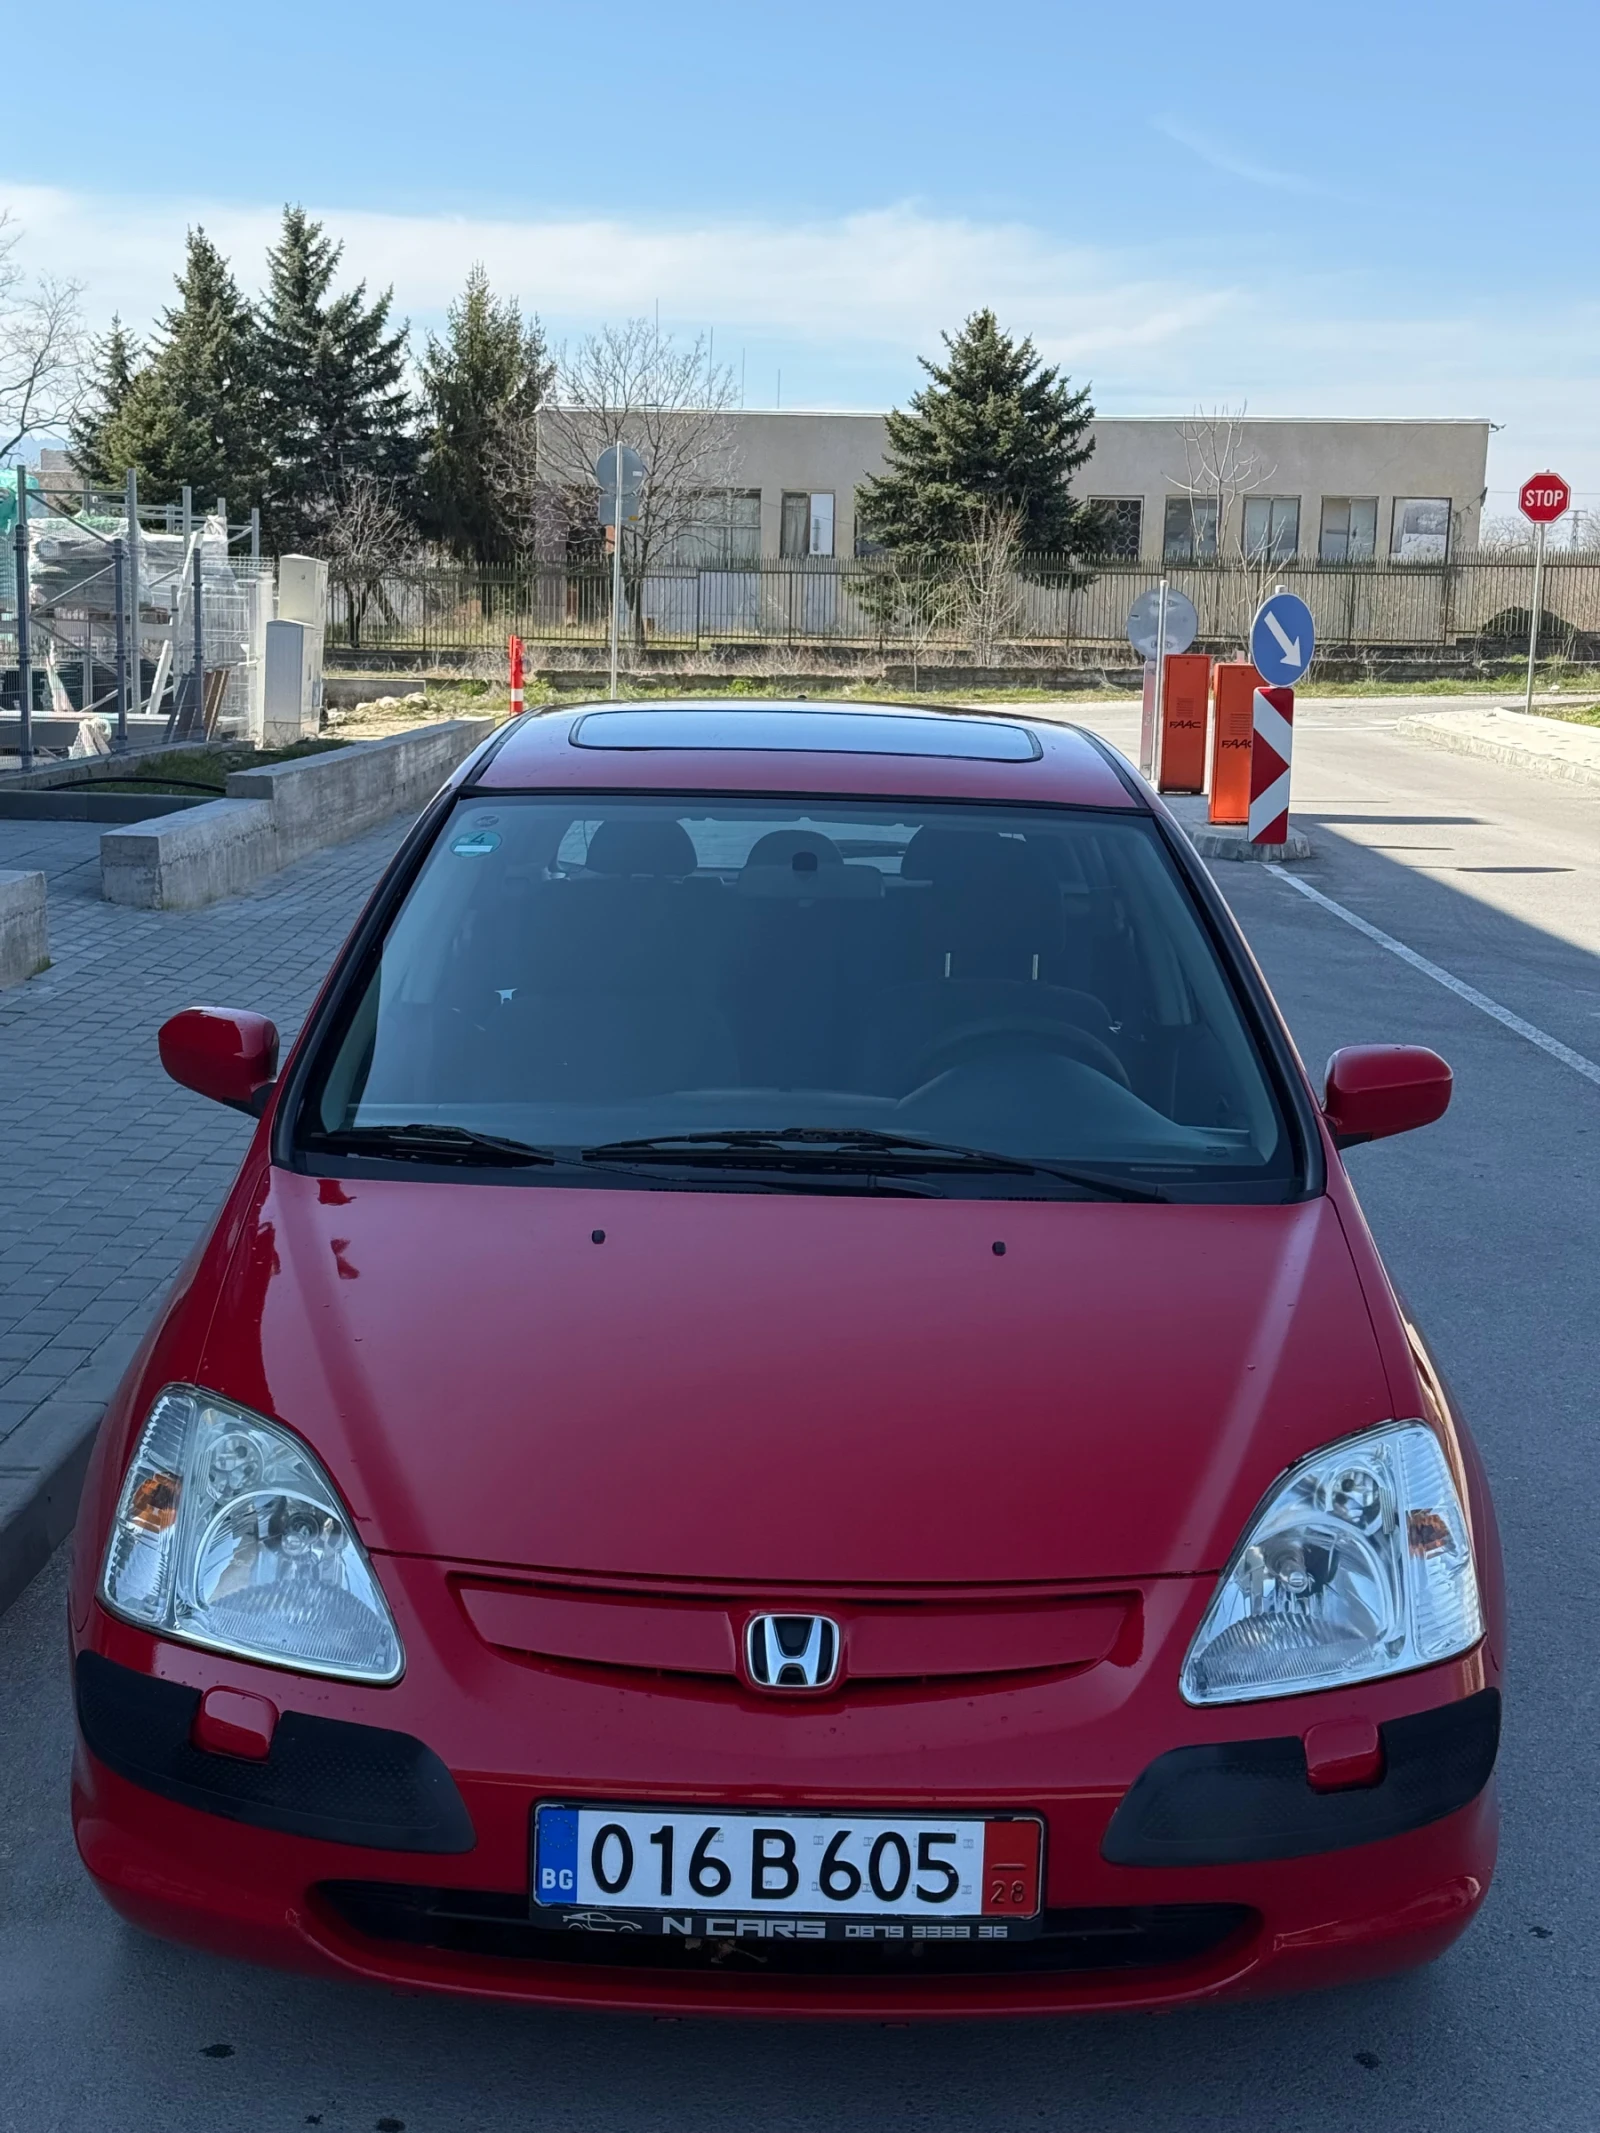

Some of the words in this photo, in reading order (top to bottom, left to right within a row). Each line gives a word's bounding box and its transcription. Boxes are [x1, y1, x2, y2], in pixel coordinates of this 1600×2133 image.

[1525, 489, 1564, 507] STOP
[1169, 720, 1201, 729] FAAC
[470, 833, 485, 844] 4
[542, 1868, 573, 1890] BG
[990, 1880, 1026, 1904] 28
[662, 1916, 692, 1935] N
[706, 1918, 826, 1939] CARS
[845, 1925, 904, 1938] 0879
[912, 1926, 970, 1938] 3333
[978, 1926, 1008, 1938] 36
